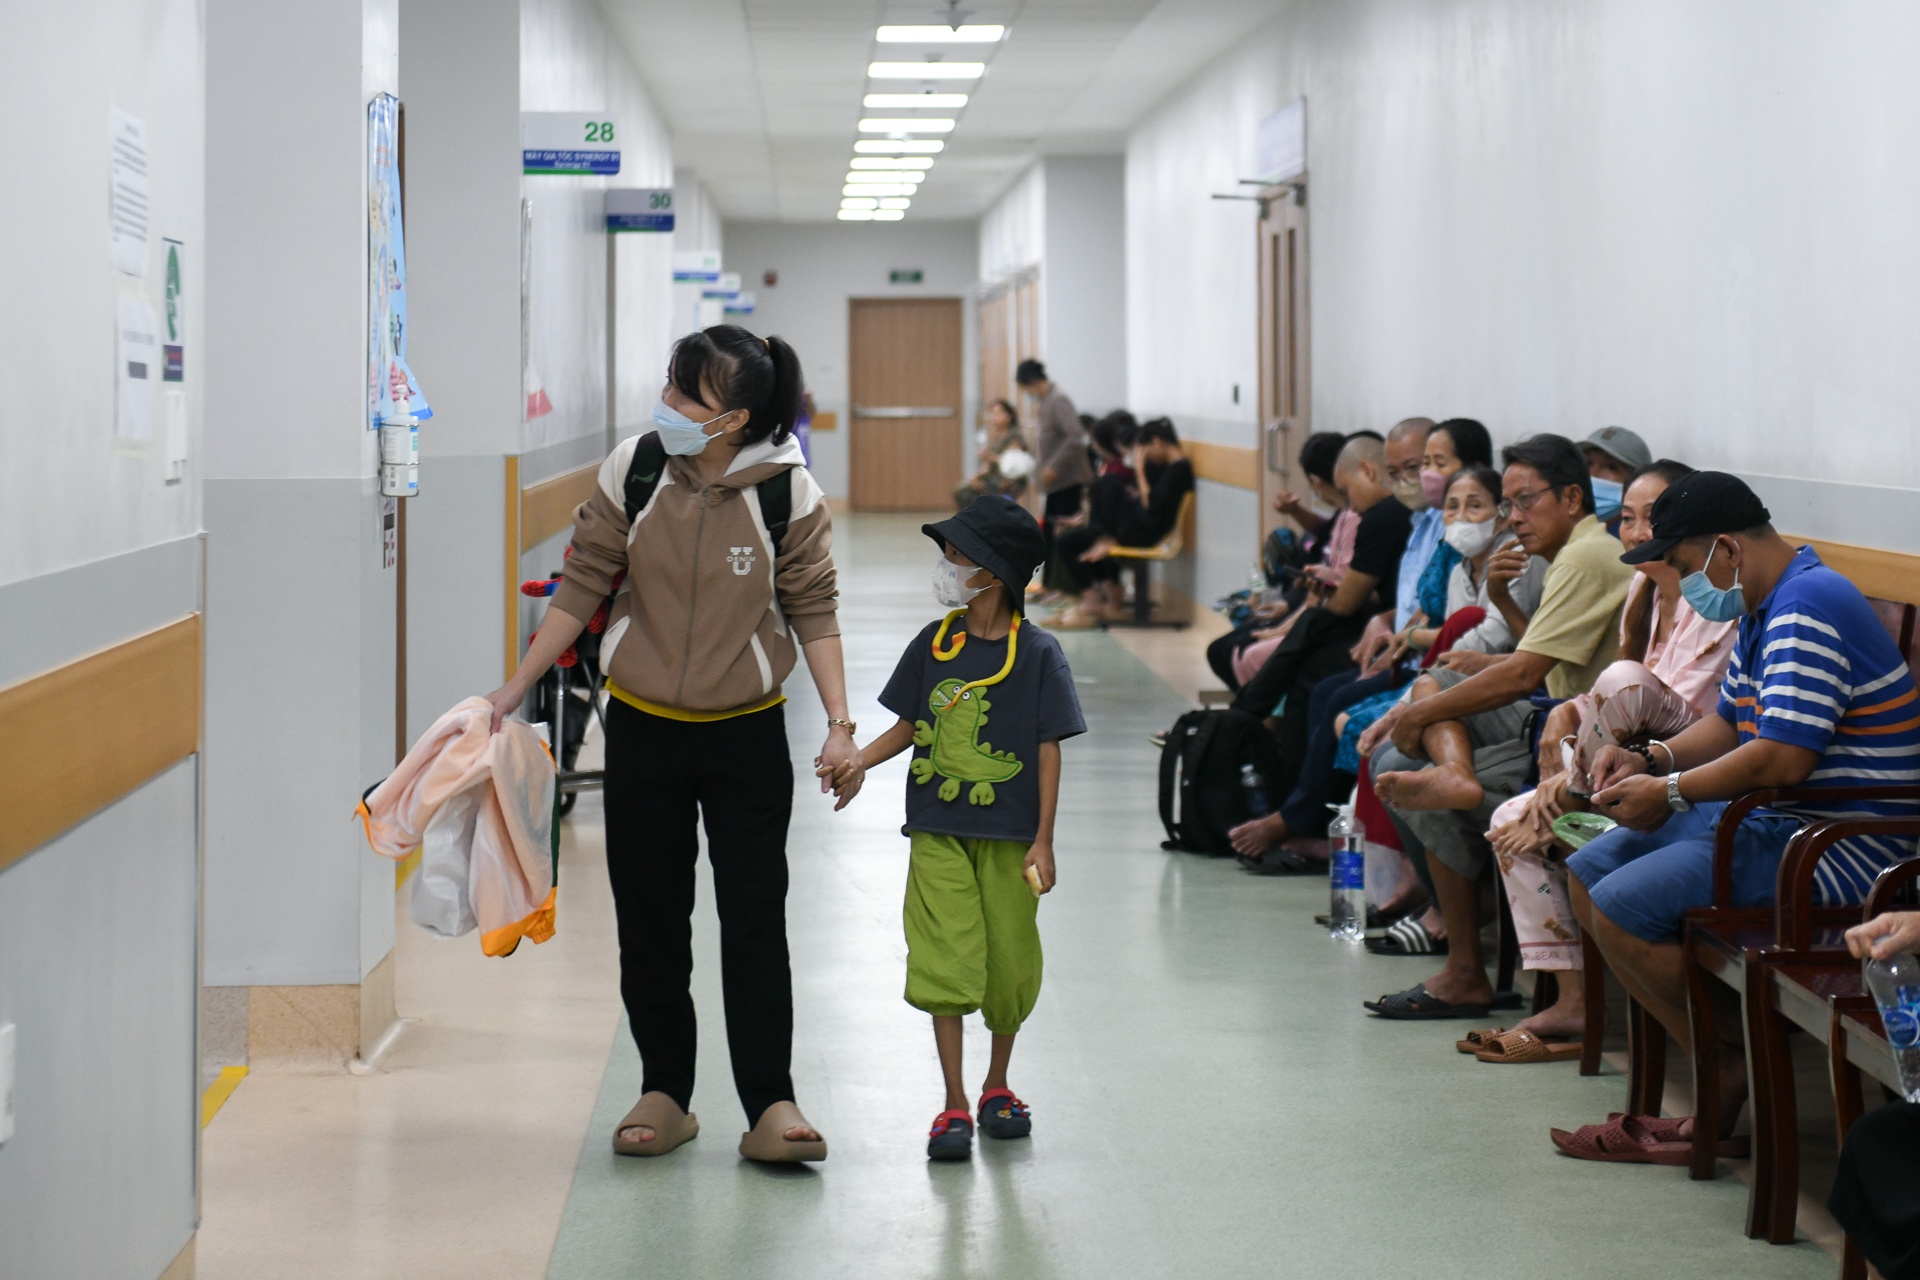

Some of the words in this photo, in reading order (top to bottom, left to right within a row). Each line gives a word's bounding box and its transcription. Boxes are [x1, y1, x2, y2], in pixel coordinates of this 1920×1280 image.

[585, 121, 615, 142] 28
[543, 152, 556, 161] GIA
[574, 152, 610, 161] SYNERGY
[554, 161, 581, 169] Synergy
[650, 193, 671, 209] 30
[730, 546, 753, 576] U
